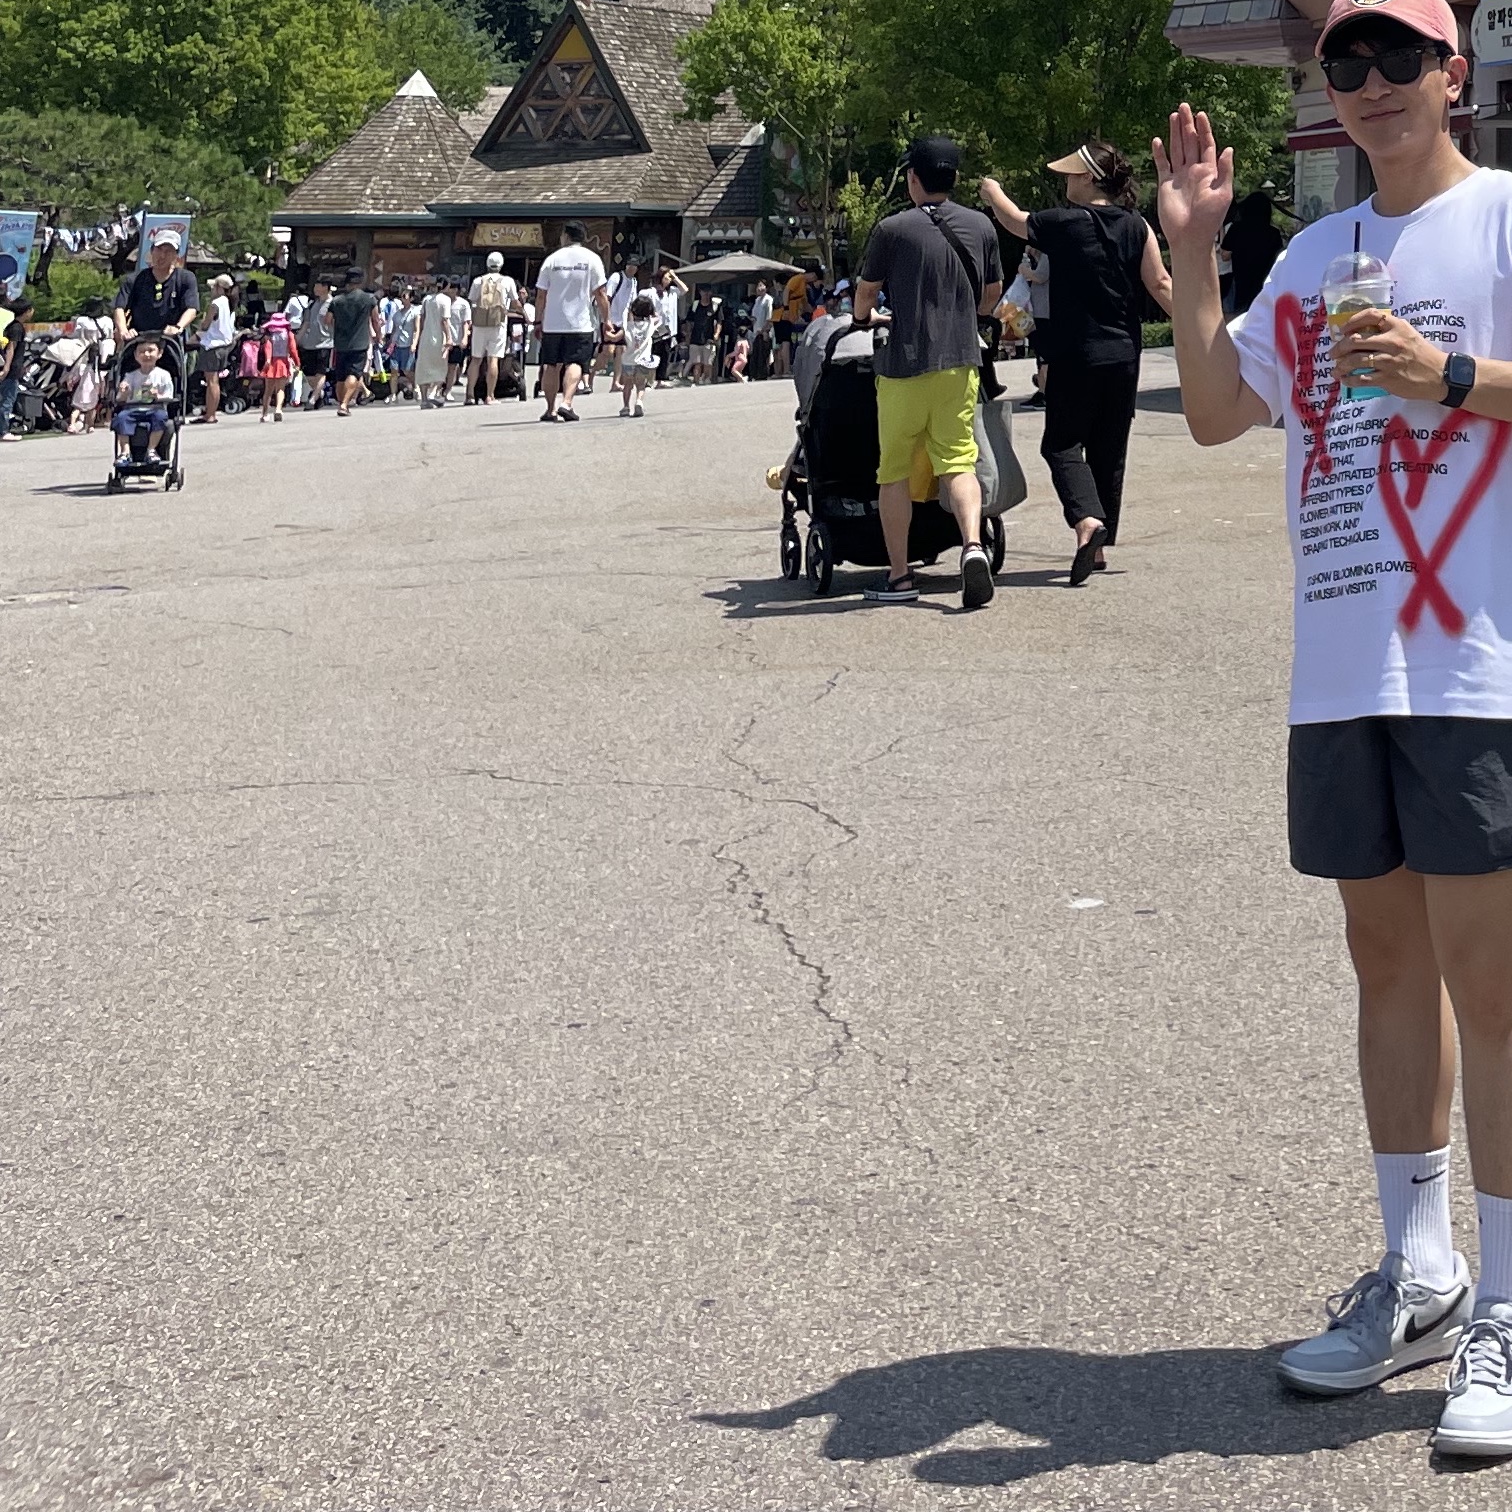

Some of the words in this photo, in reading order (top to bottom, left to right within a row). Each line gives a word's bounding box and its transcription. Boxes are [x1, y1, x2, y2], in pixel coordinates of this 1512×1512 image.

[1404, 428, 1429, 440] AND
[1431, 429, 1449, 441] SO
[1389, 461, 1448, 475] CREATING
